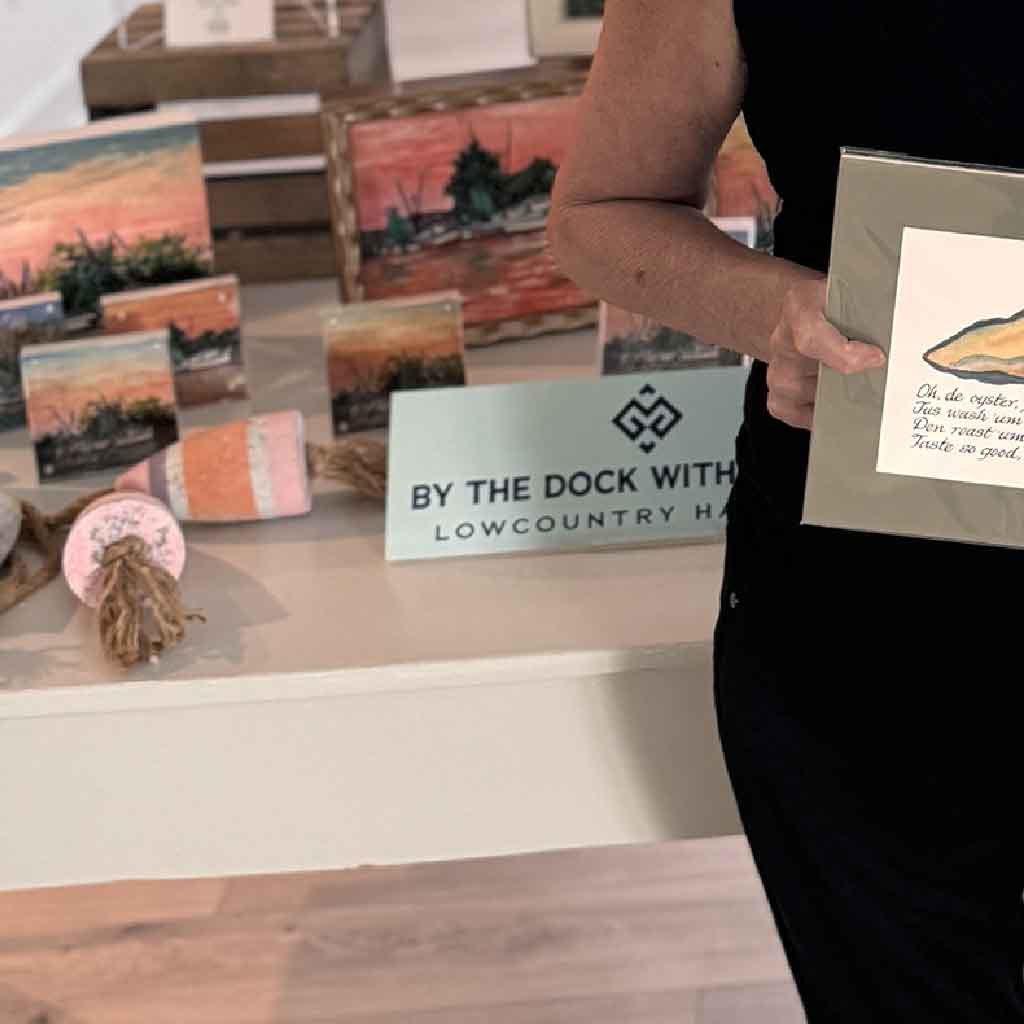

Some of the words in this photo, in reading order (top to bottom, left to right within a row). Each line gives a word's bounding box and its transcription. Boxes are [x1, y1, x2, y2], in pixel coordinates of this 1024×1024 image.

[945, 387, 963, 402] de
[970, 393, 1019, 410] oyster,
[913, 416, 945, 432] Den
[951, 426, 994, 439] roast
[998, 431, 1024, 442] um
[947, 409, 987, 422] wash
[911, 433, 954, 453] Taste
[958, 444, 977, 454] so
[976, 446, 1021, 461] good,
[412, 482, 454, 509] BY
[466, 476, 532, 505] THE
[545, 467, 638, 499] DOCK
[651, 460, 735, 489] WITH
[435, 505, 675, 541] LOWCOUNTRY
